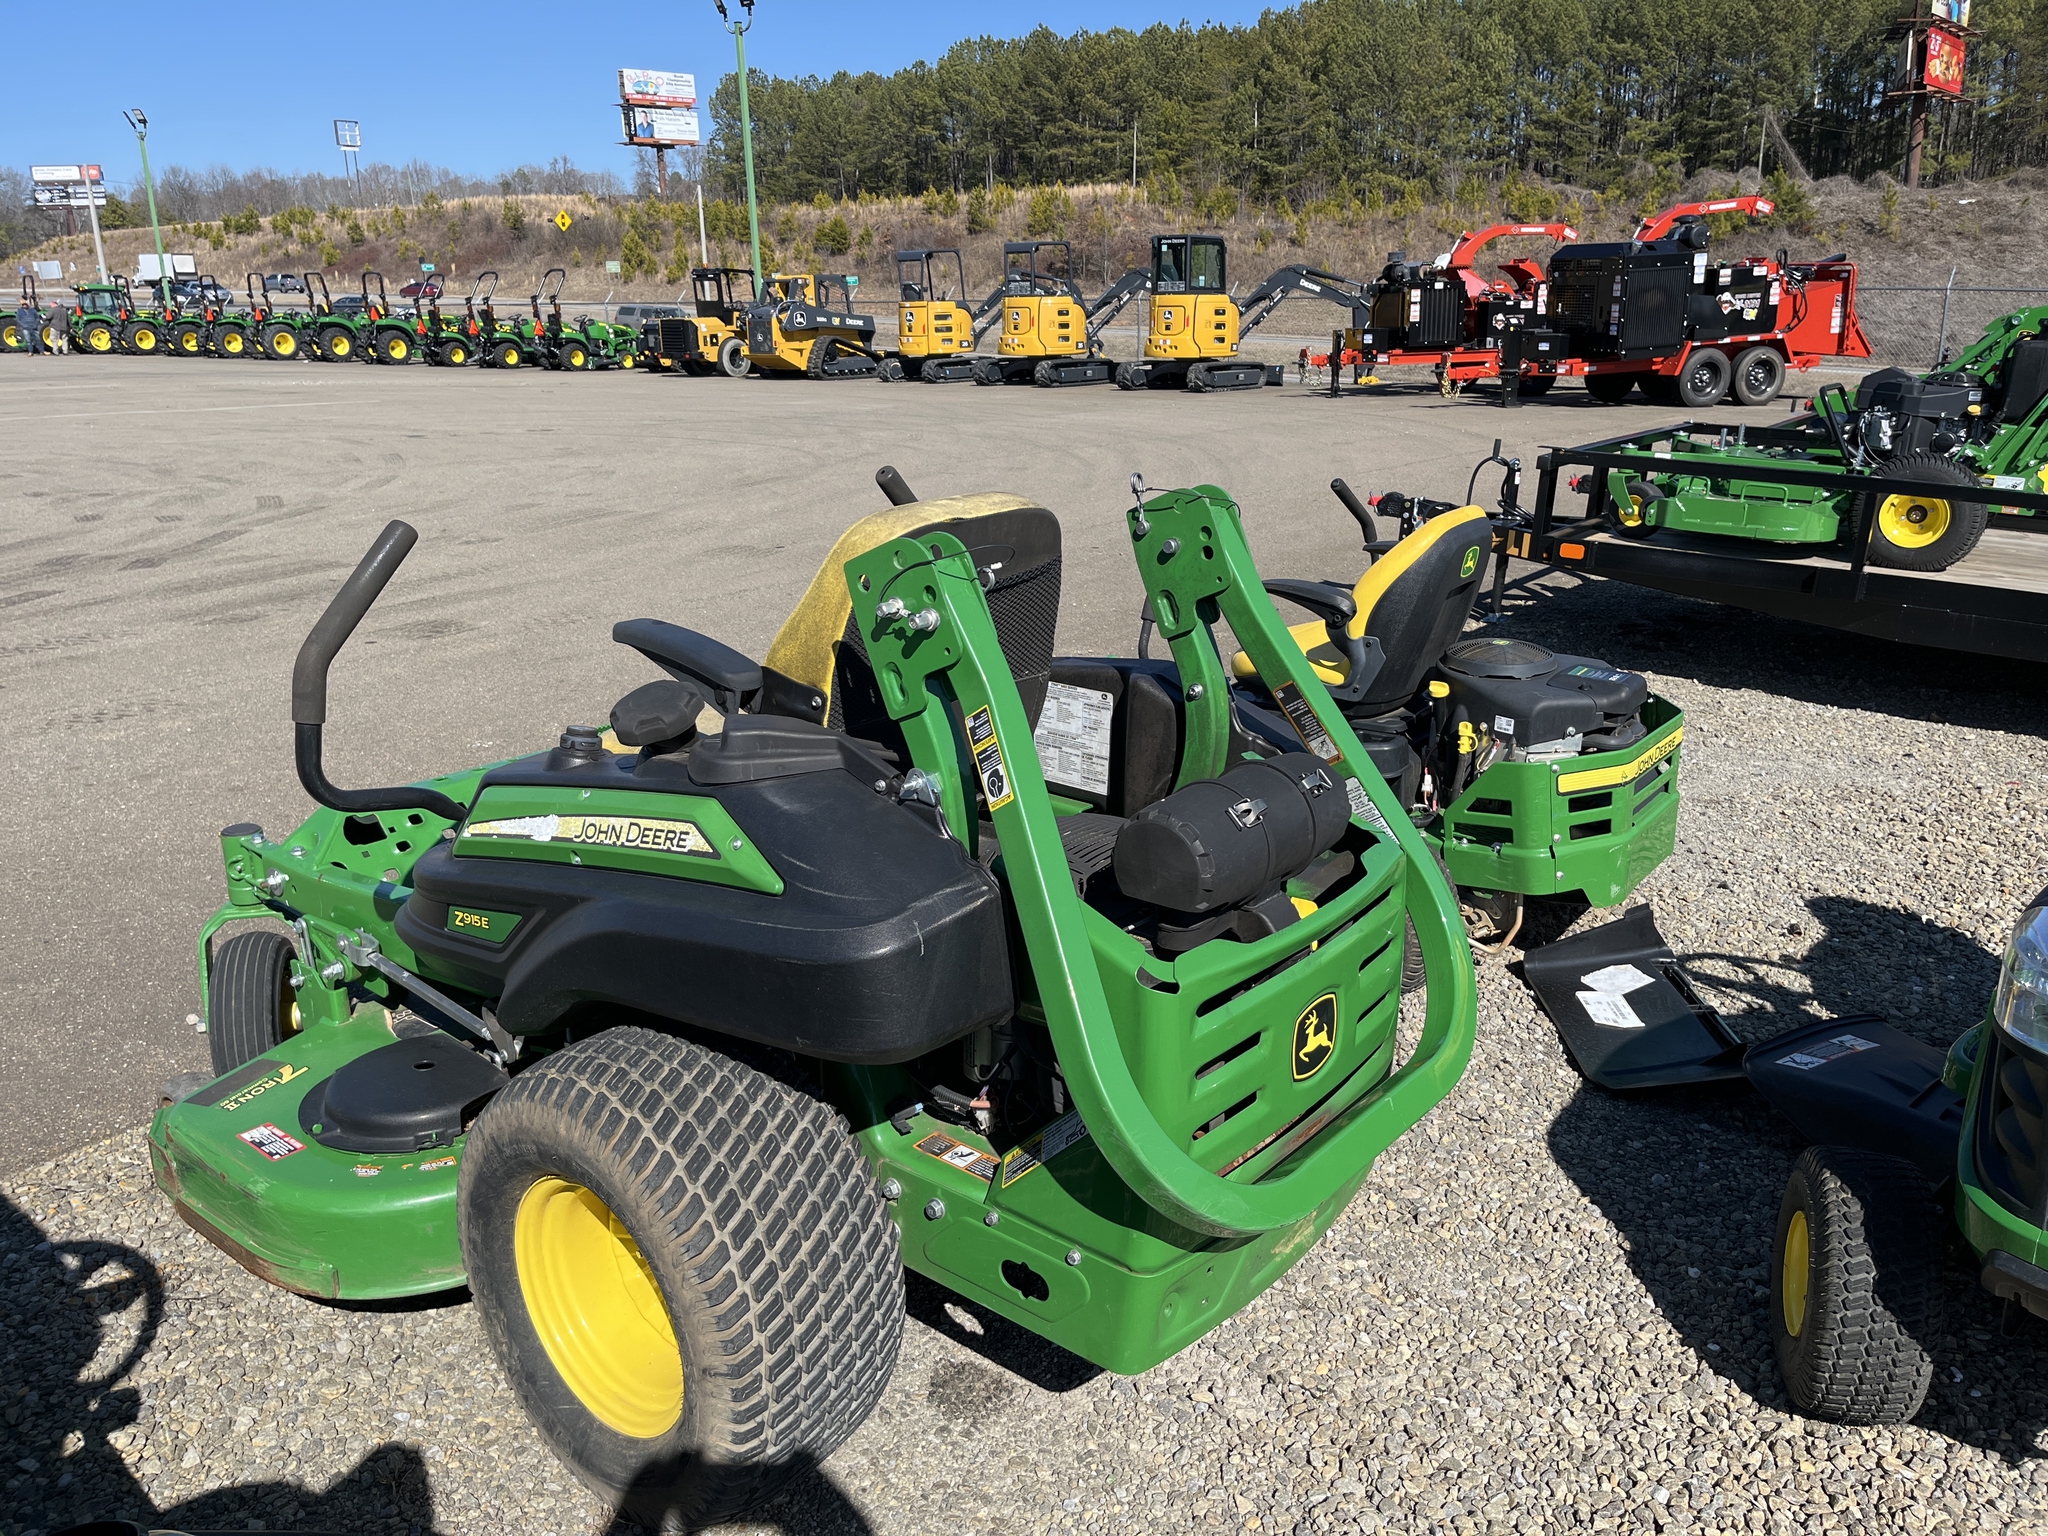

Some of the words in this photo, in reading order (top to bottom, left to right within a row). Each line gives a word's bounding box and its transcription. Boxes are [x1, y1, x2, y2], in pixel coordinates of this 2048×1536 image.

[1300, 279, 1321, 292] DEERE
[845, 317, 864, 326] DEERE
[1634, 752, 1655, 777] JOHN
[1654, 736, 1676, 761] DEERE
[573, 819, 622, 844] JOHN
[625, 822, 690, 849] DEERE
[454, 911, 489, 929] Z915E
